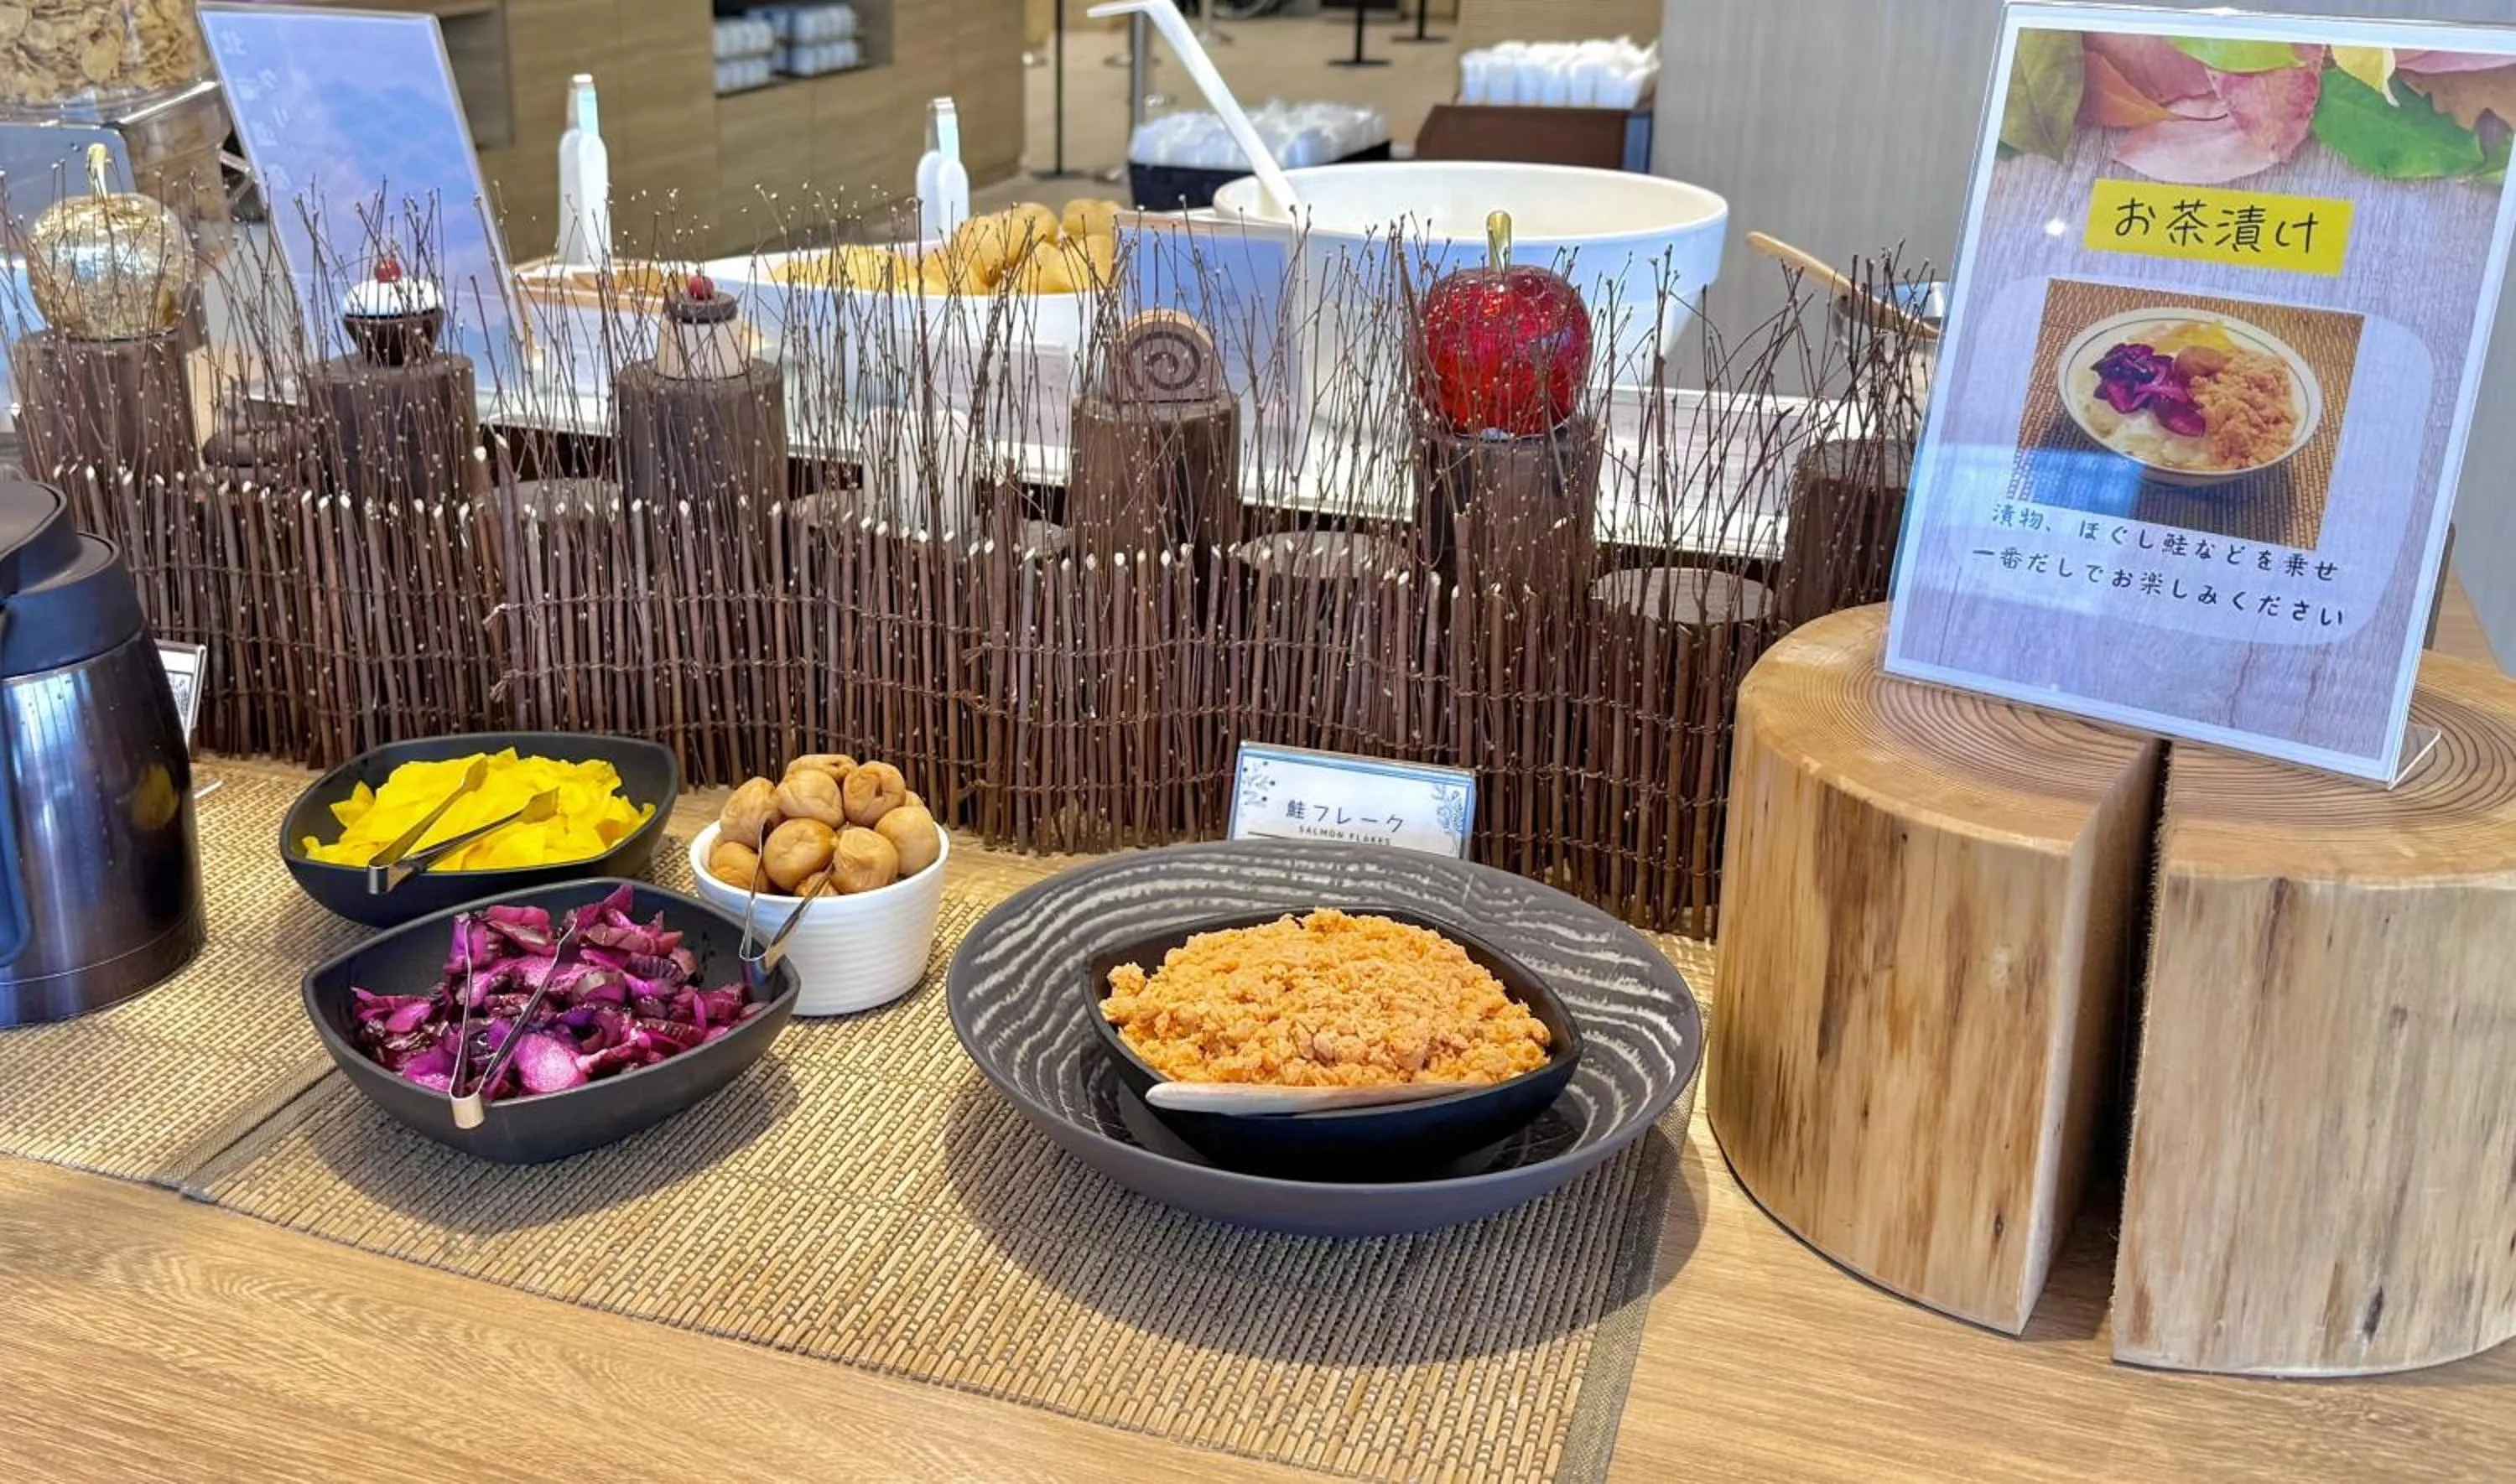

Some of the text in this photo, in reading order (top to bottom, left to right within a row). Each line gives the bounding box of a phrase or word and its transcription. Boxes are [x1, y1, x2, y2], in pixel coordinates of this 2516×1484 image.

[2115, 197, 2318, 253] お茶漬け
[1973, 547, 2343, 625] 一番だしでお楽しみください
[1285, 799, 1404, 833] 鮭フレーク
[1298, 824, 1344, 839] SALMON
